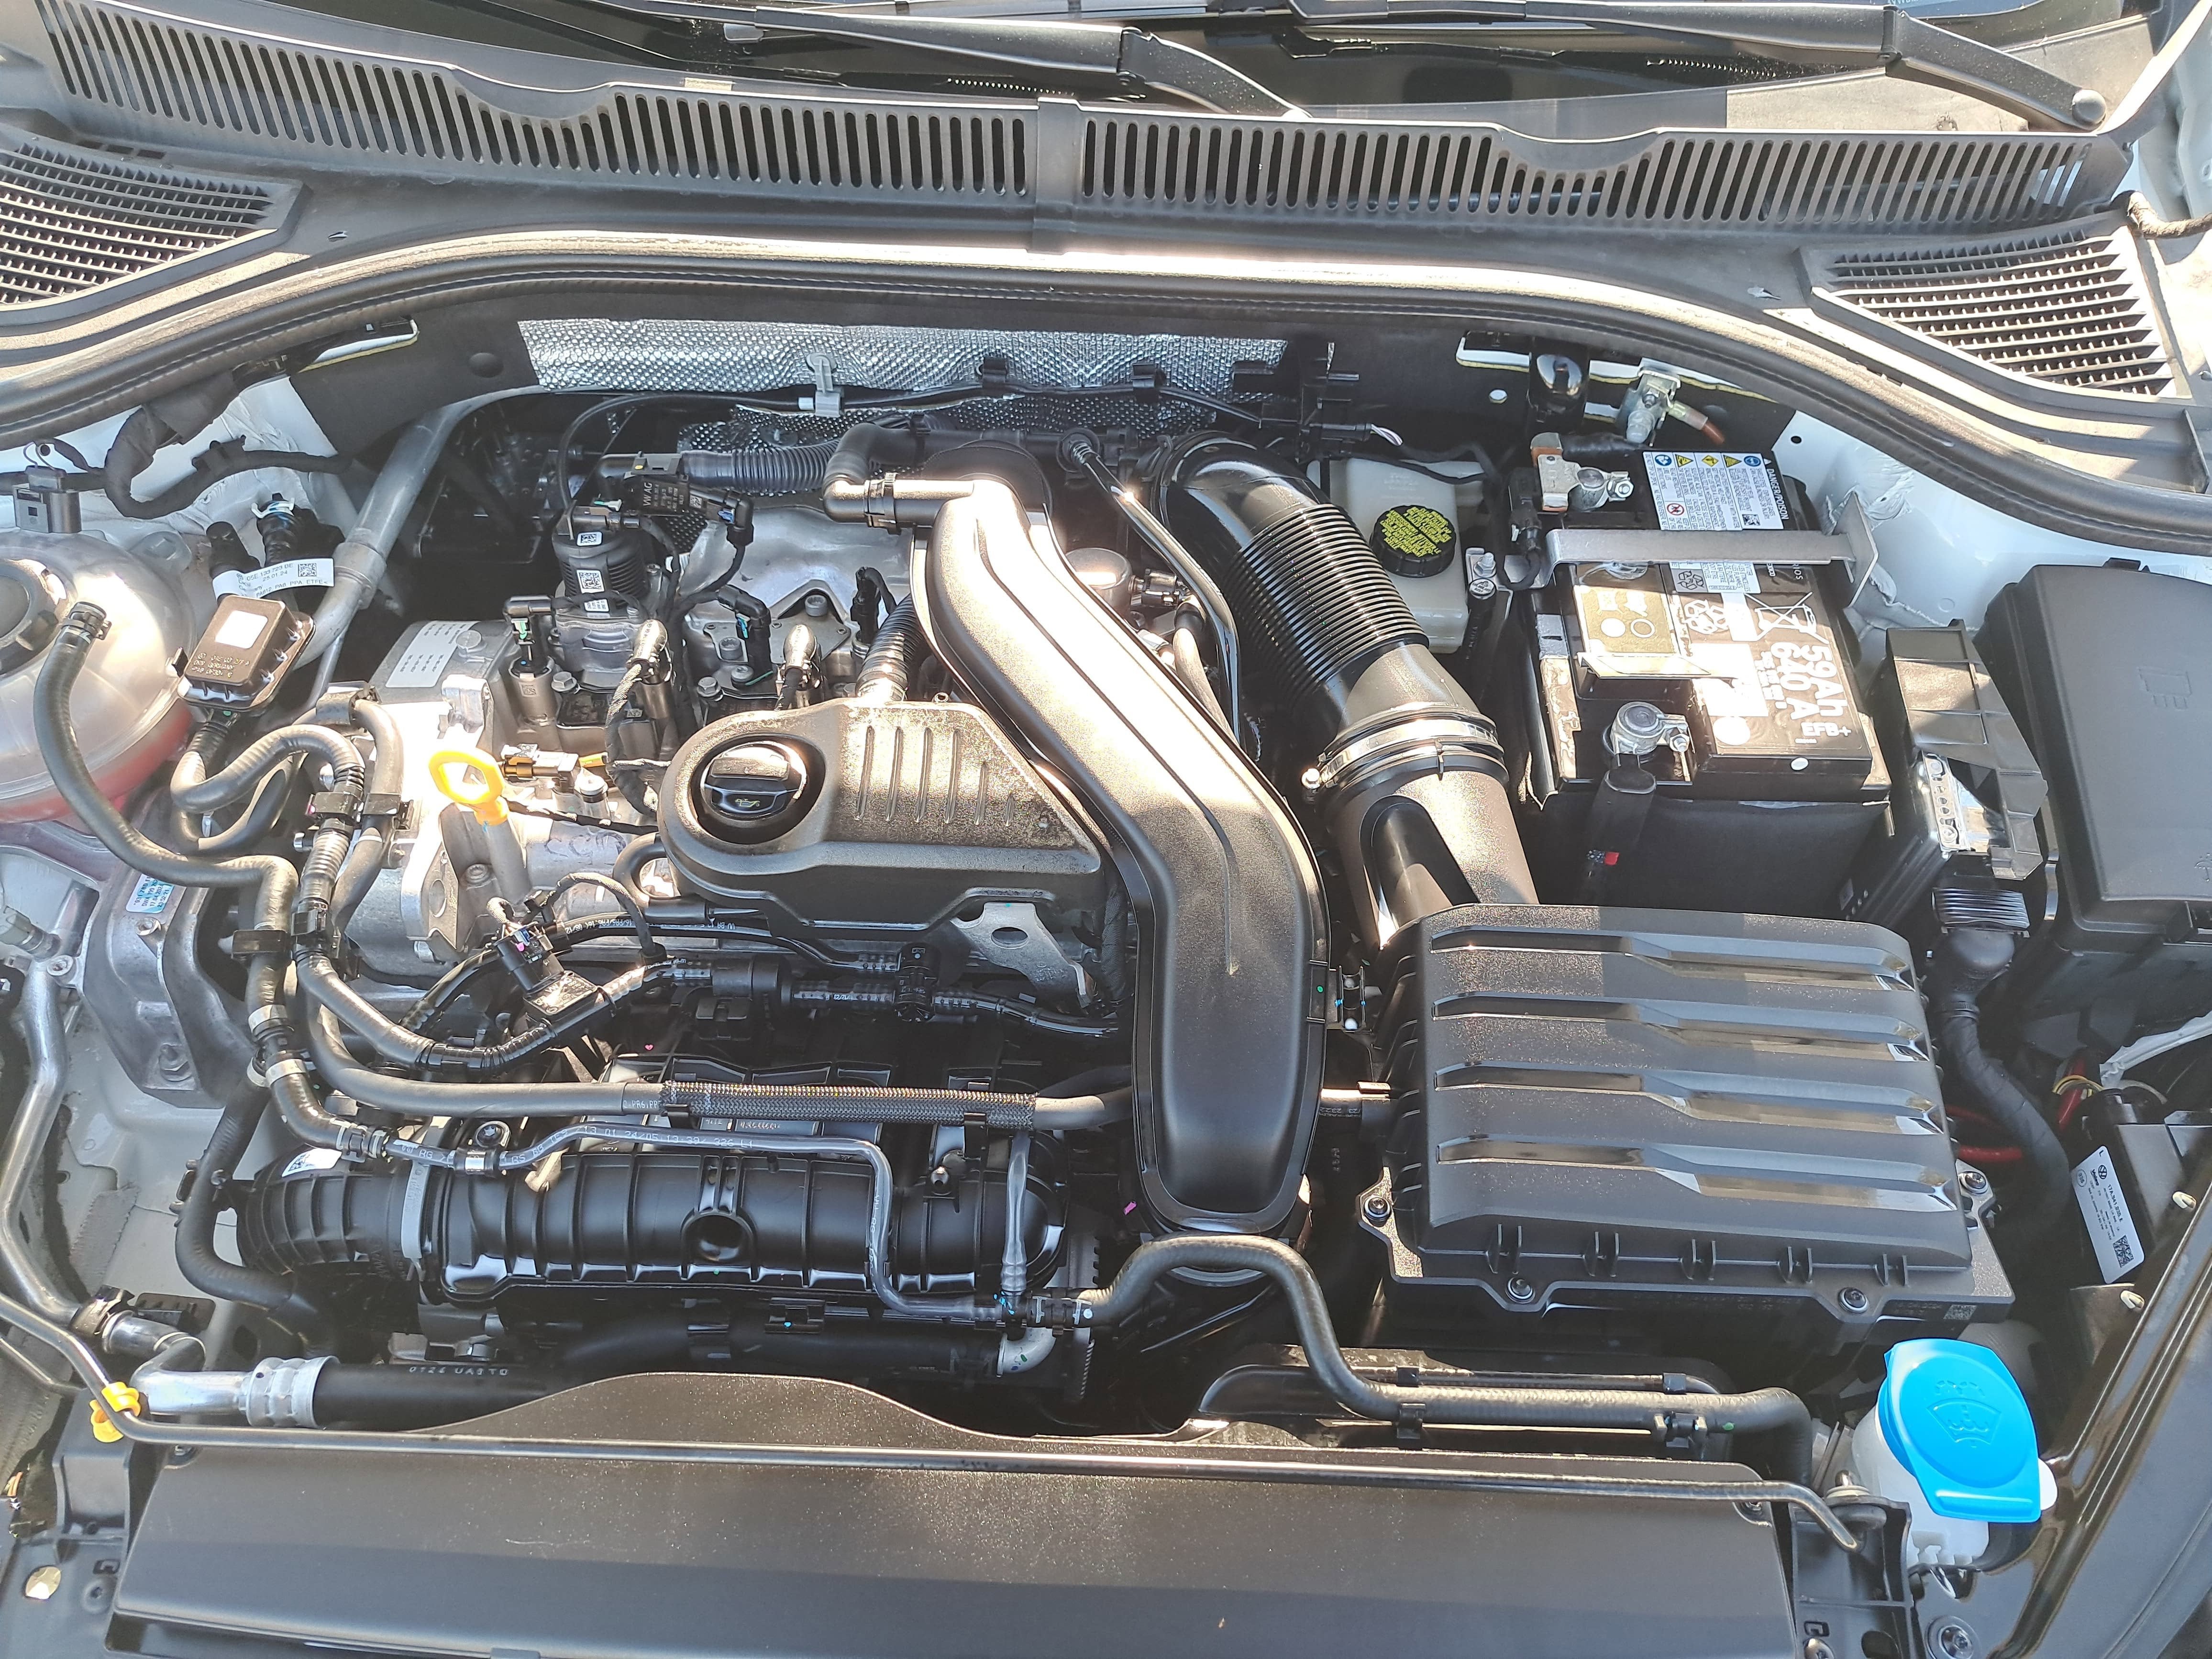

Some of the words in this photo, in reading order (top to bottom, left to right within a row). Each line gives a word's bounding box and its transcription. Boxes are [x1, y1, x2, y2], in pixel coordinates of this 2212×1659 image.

[644, 482, 653, 494] AG
[1766, 468, 1789, 520] DANGER/POISON
[1770, 641, 1812, 691] 640
[1800, 644, 1848, 717] 59Ah
[1786, 697, 1820, 720] A
[1801, 722, 1852, 737] EFB+
